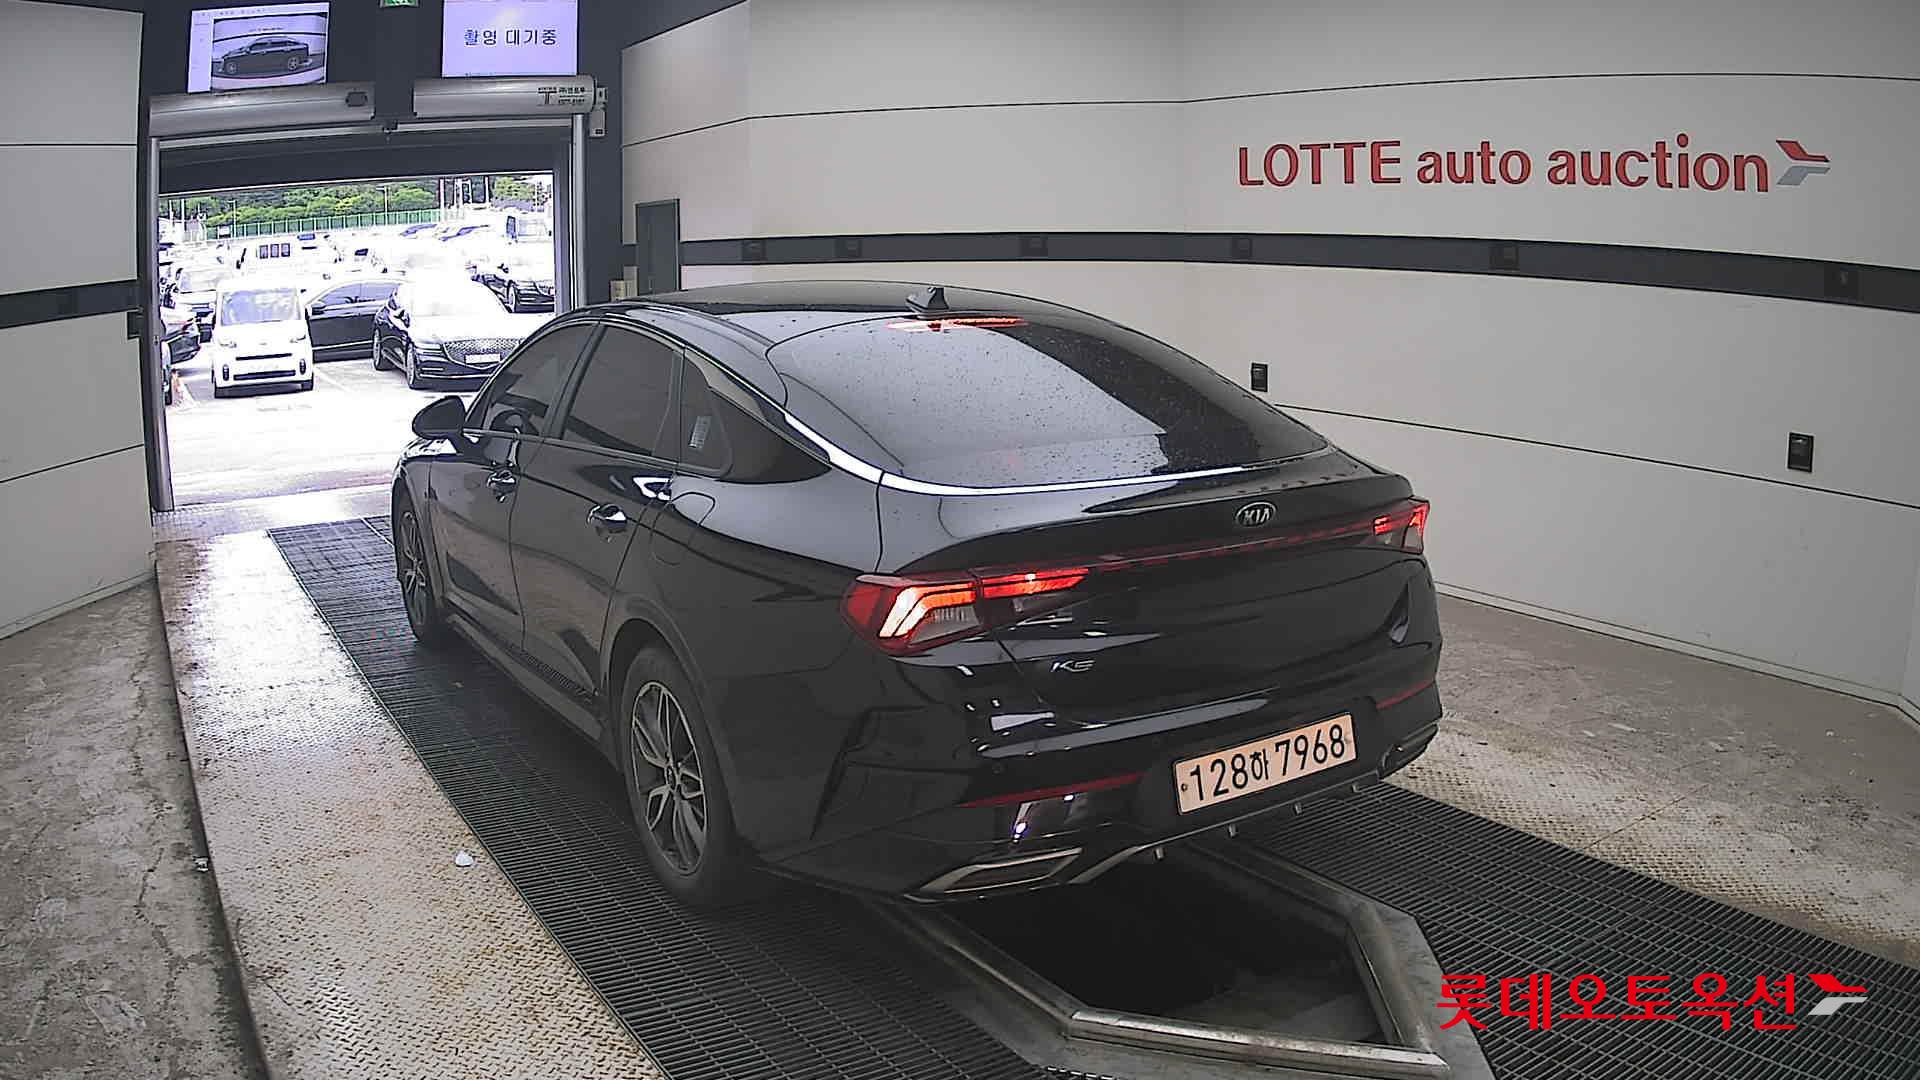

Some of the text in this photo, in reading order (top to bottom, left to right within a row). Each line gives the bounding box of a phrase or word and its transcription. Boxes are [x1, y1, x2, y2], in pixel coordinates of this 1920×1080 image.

[505, 28, 557, 46] 대기중
[1238, 133, 1769, 193] LOTTE auto auction
[1243, 508, 1271, 524] KIA
